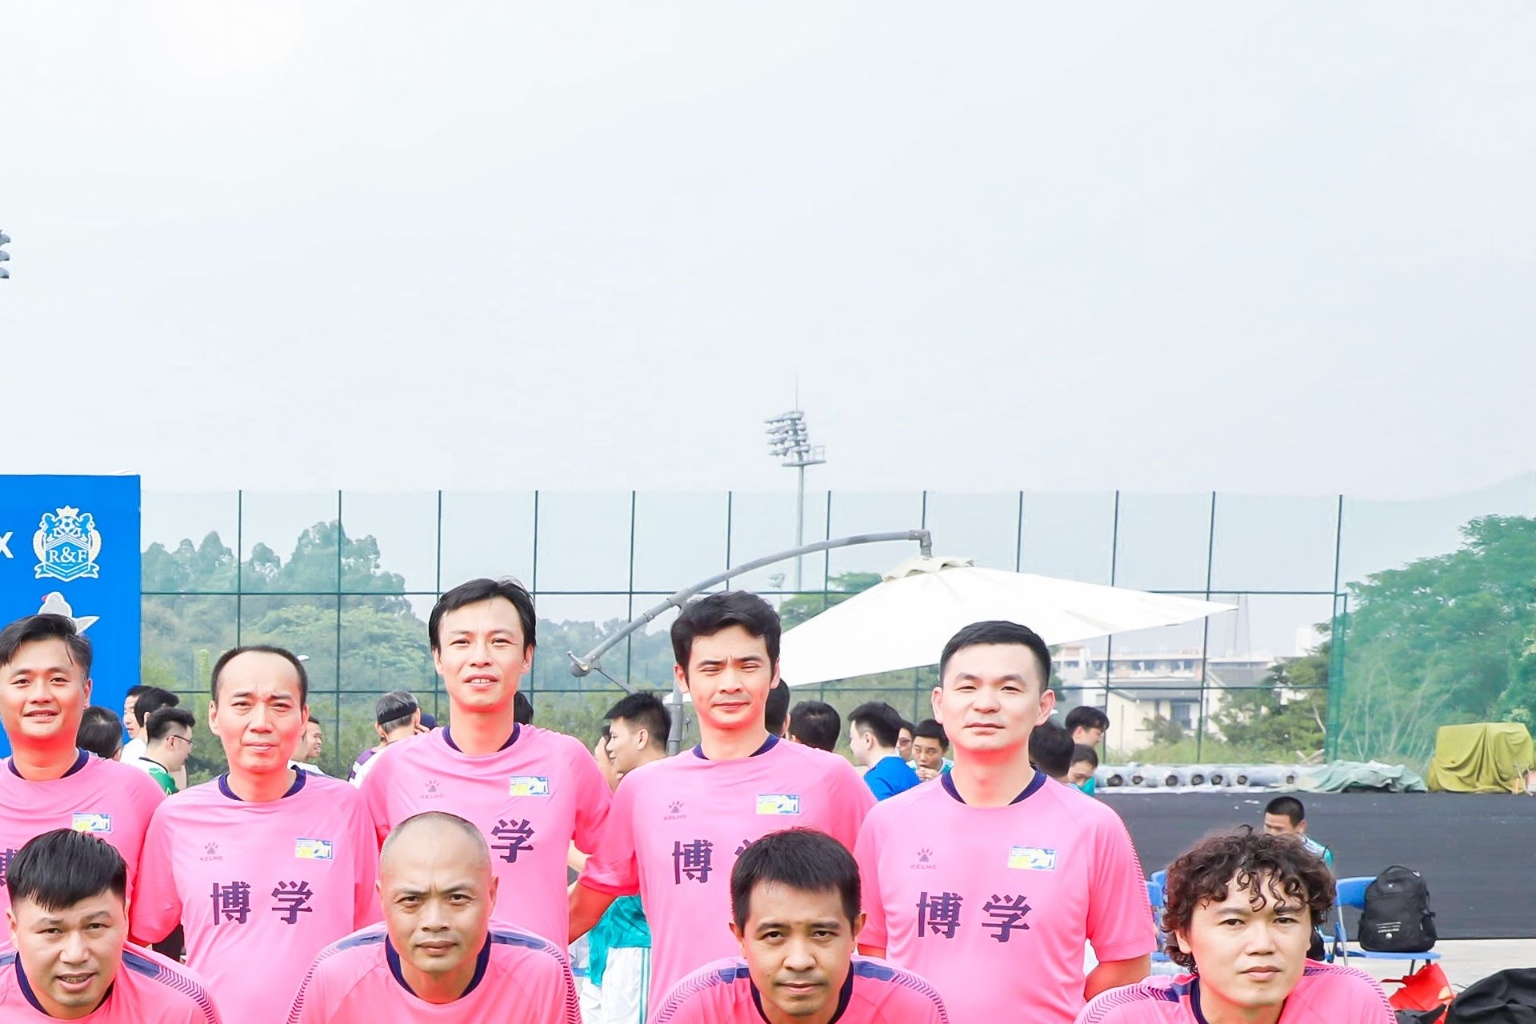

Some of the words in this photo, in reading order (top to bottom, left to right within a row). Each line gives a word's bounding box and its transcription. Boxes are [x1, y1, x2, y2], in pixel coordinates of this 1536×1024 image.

[49, 547, 88, 563] R&F
[210, 880, 313, 925] 博学
[916, 891, 1031, 942] 博学
